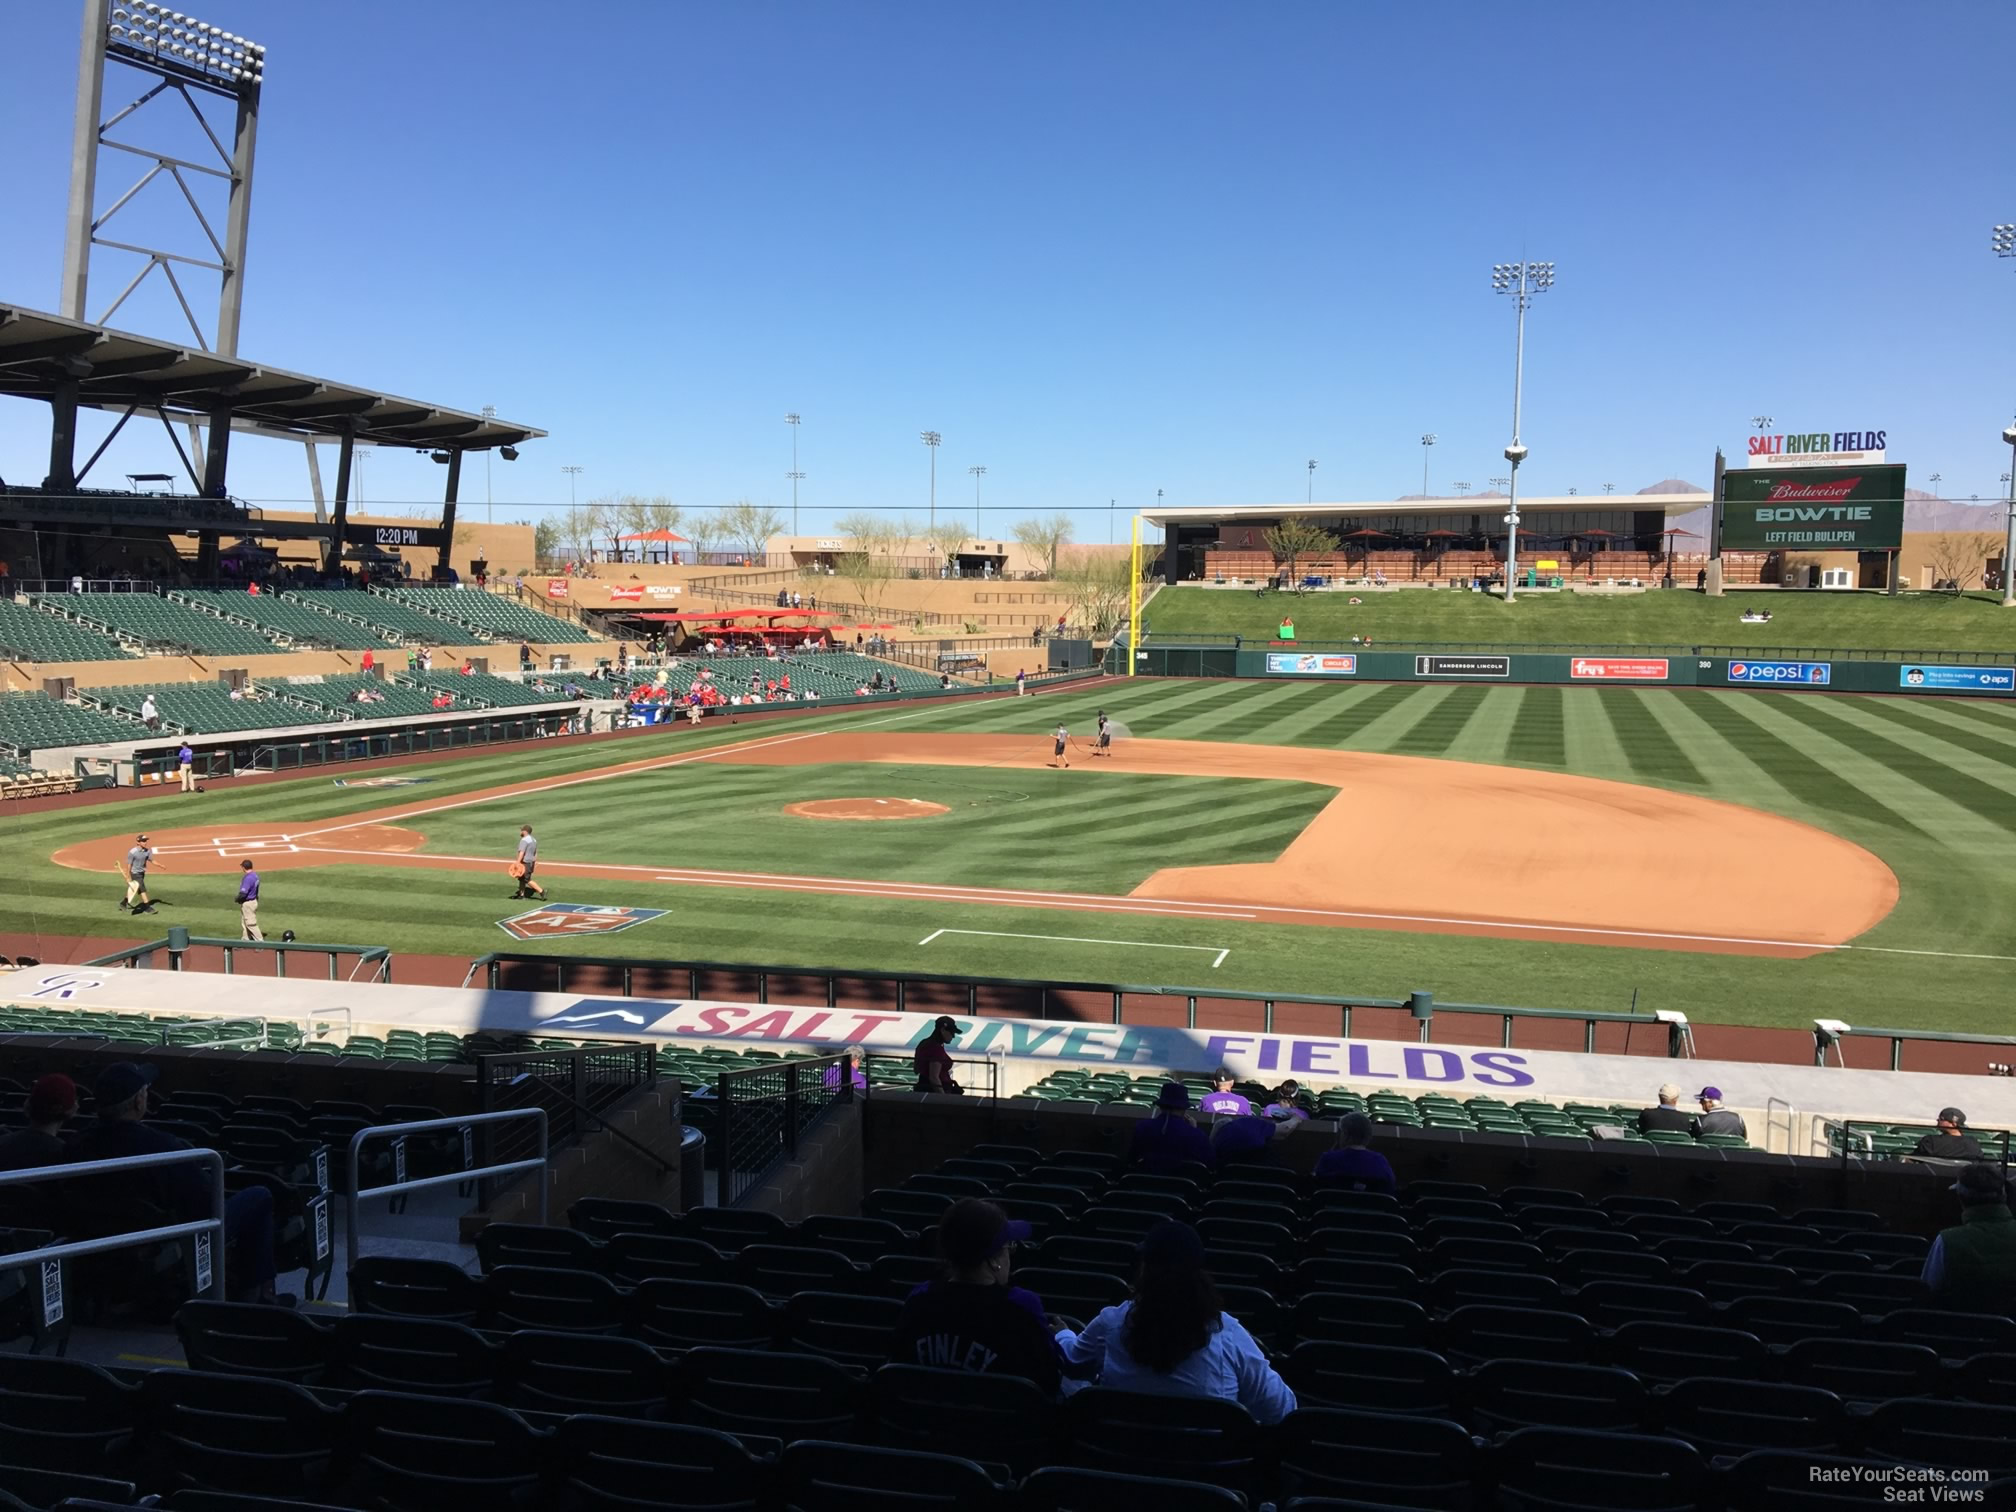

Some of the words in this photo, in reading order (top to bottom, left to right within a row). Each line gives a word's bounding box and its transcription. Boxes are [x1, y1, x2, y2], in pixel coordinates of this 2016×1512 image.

[1748, 435, 1784, 455] SALT
[1786, 433, 1831, 454] RIVER
[1834, 431, 1887, 452] FIELDS
[1770, 484, 1852, 499] Budweiser
[1755, 506, 1872, 522] BOWTIE
[376, 528, 401, 544] 12:20
[402, 529, 418, 545] PM
[1765, 531, 1787, 543] LEFT
[1788, 531, 1813, 542] FIELD
[1814, 531, 1855, 542] BULLPEN
[1575, 660, 1605, 675] fry's
[1749, 665, 1801, 680] pepsi
[1991, 676, 2009, 684] aps
[524, 915, 618, 930] AZ
[677, 1006, 902, 1044] SALT
[1204, 1036, 1535, 1086] FIELDS
[46, 1271, 59, 1287] SALT
[46, 1290, 60, 1303] FIELDS
[916, 1332, 998, 1373] FINLEY
